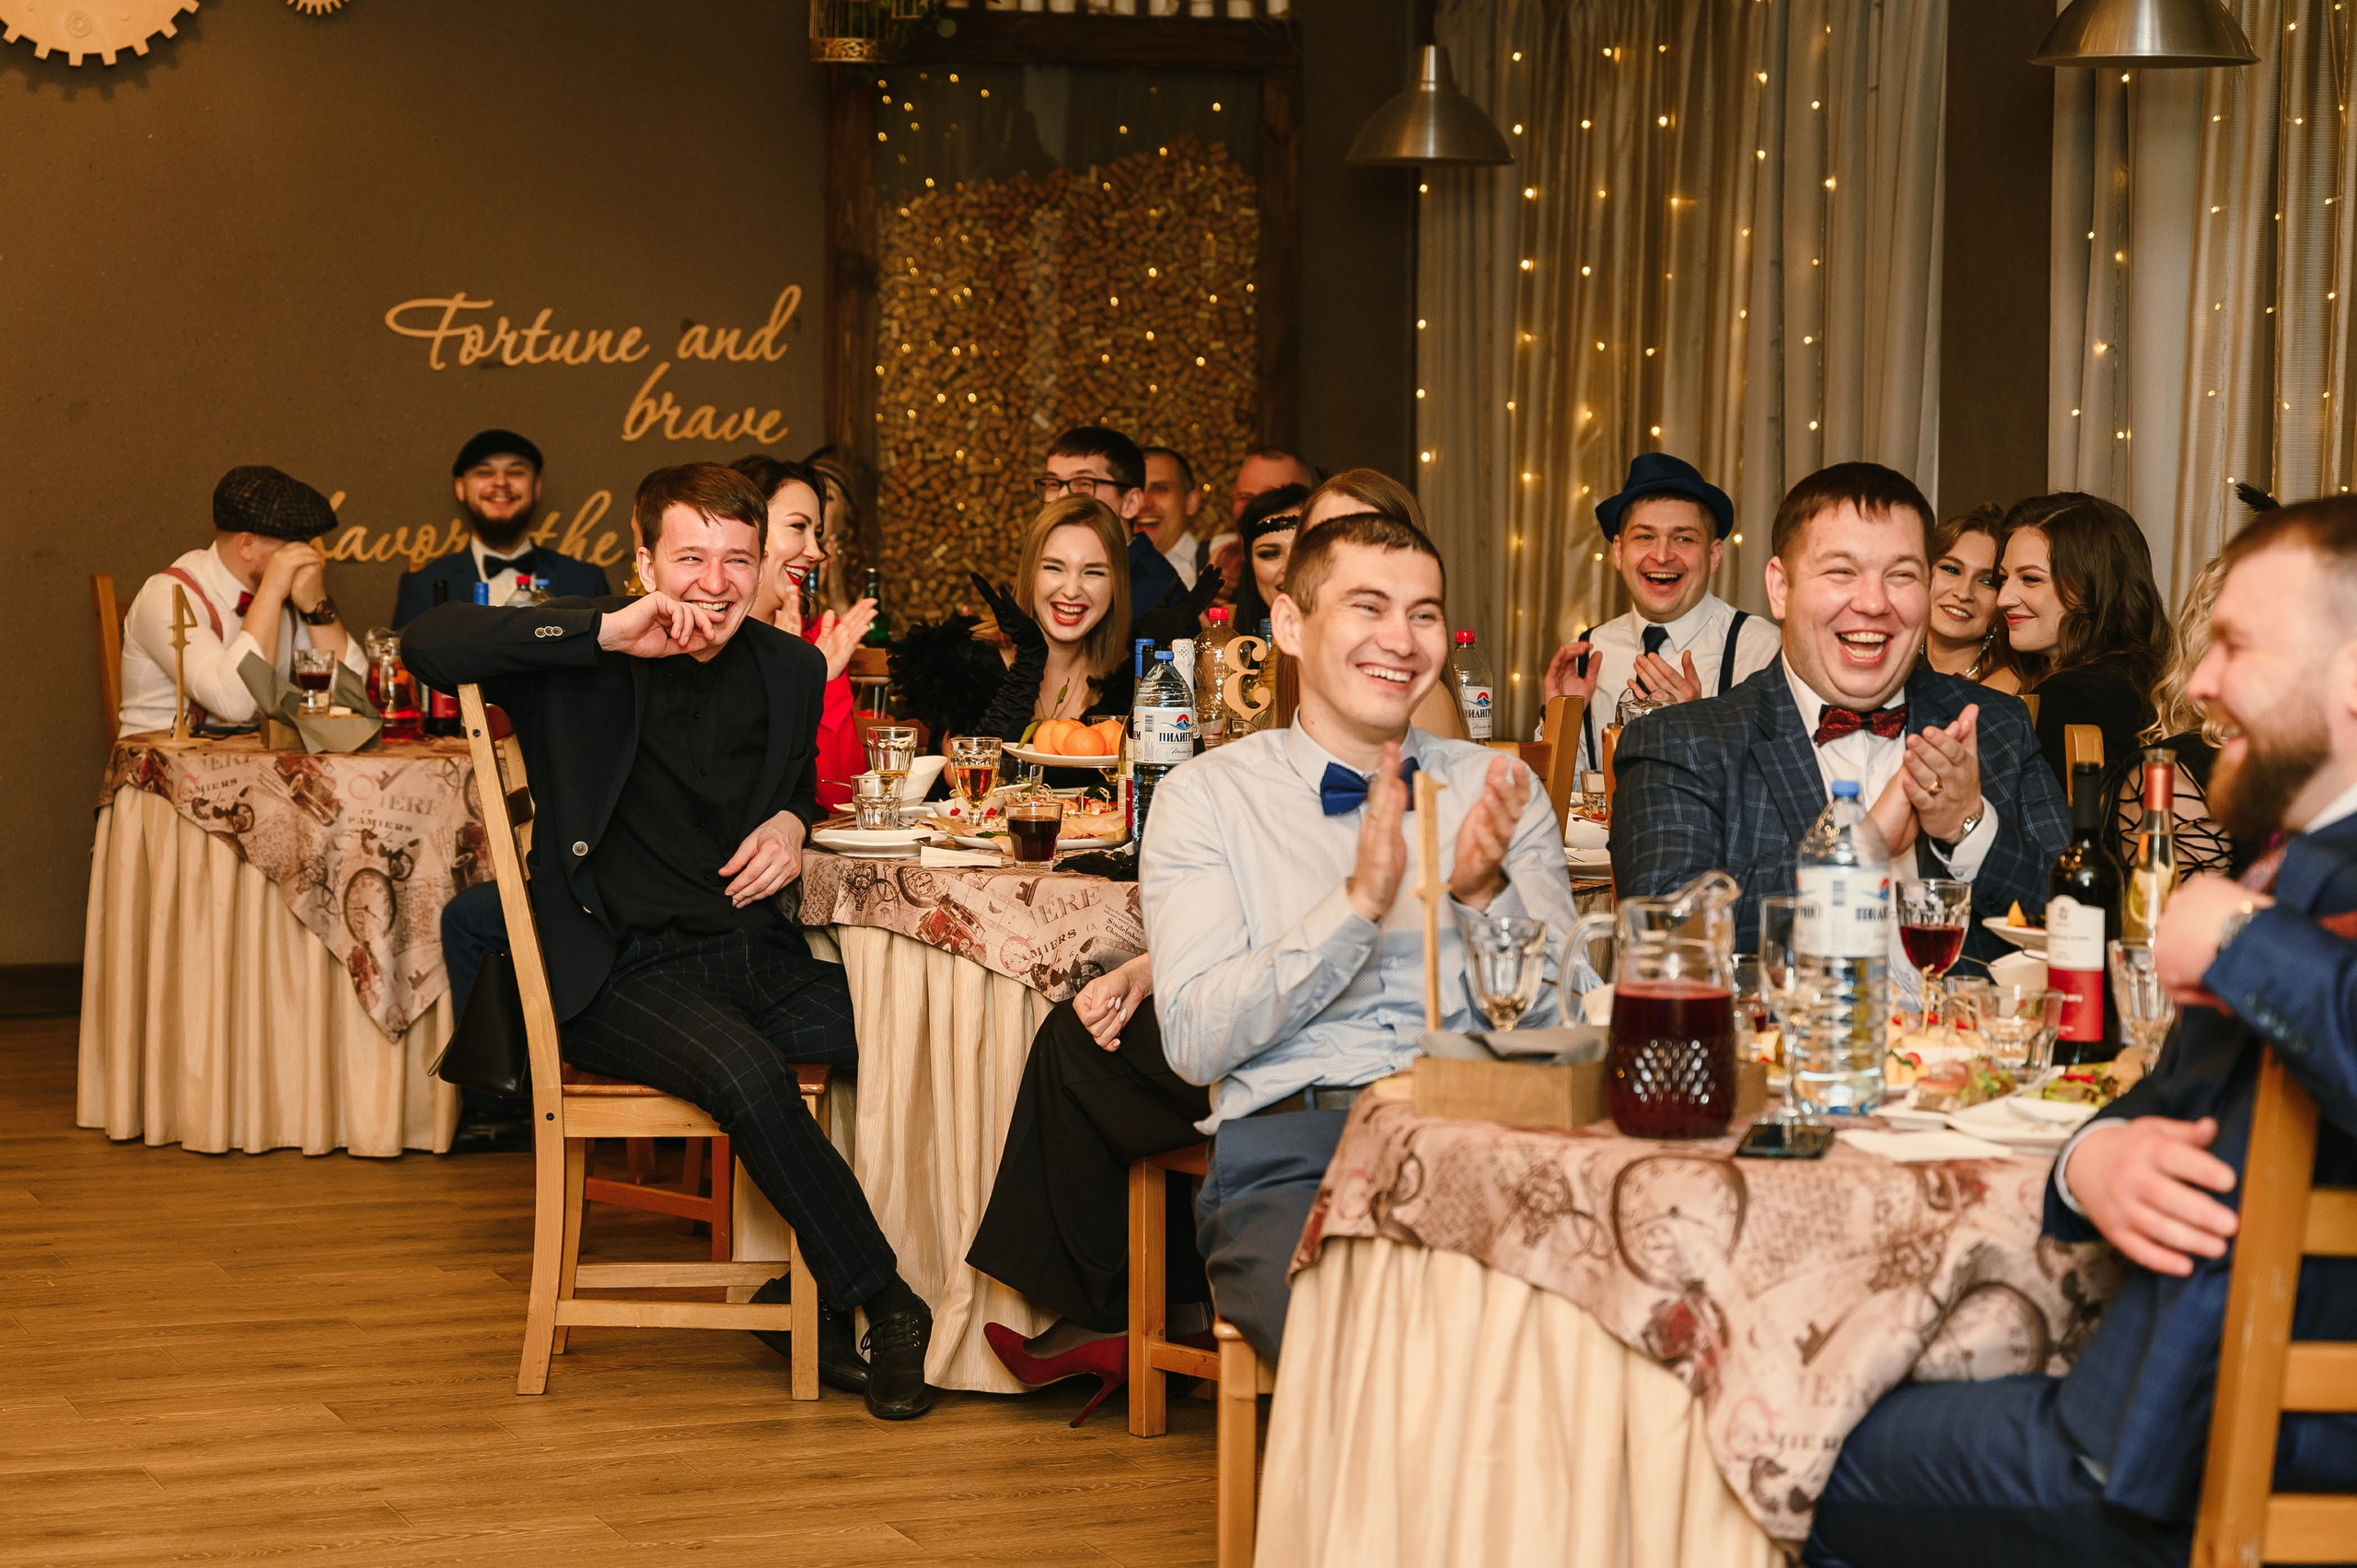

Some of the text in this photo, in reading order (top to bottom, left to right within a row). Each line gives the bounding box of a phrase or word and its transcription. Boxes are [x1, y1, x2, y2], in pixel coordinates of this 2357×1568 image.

[384, 285, 802, 371] Fortune and
[621, 362, 789, 445] brave
[1105, 925, 1135, 949] Champion
[1106, 917, 1142, 944] Studebaker
